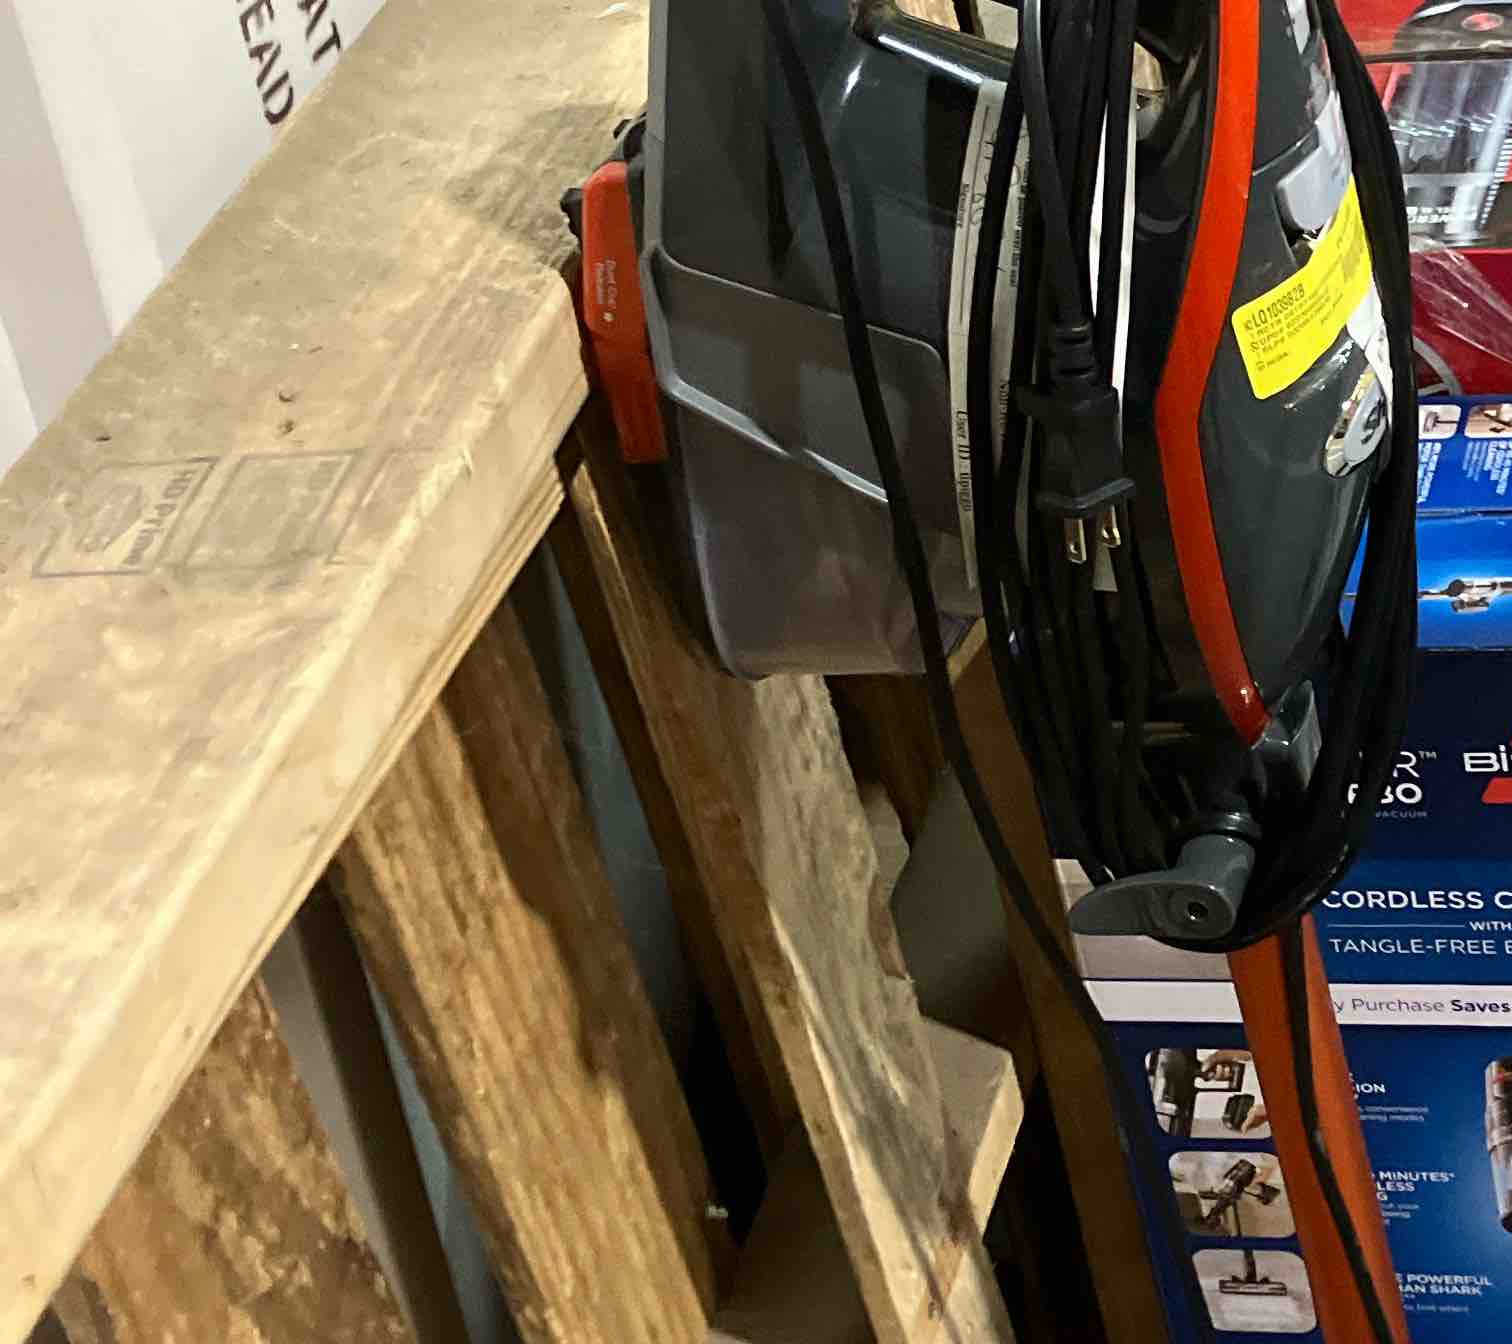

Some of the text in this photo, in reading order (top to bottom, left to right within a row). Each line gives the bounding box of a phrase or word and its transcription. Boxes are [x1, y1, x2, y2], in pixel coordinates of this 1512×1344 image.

[1321, 889, 1484, 910] CORDLESS
[1469, 920, 1512, 932] WITH
[1329, 938, 1497, 956] TANGLE-FREE
[1351, 997, 1446, 1014] Purchase
[1450, 998, 1512, 1014] Saves
[1407, 1273, 1493, 1287] POWERFUL
[1429, 1284, 1482, 1297] SHARK
